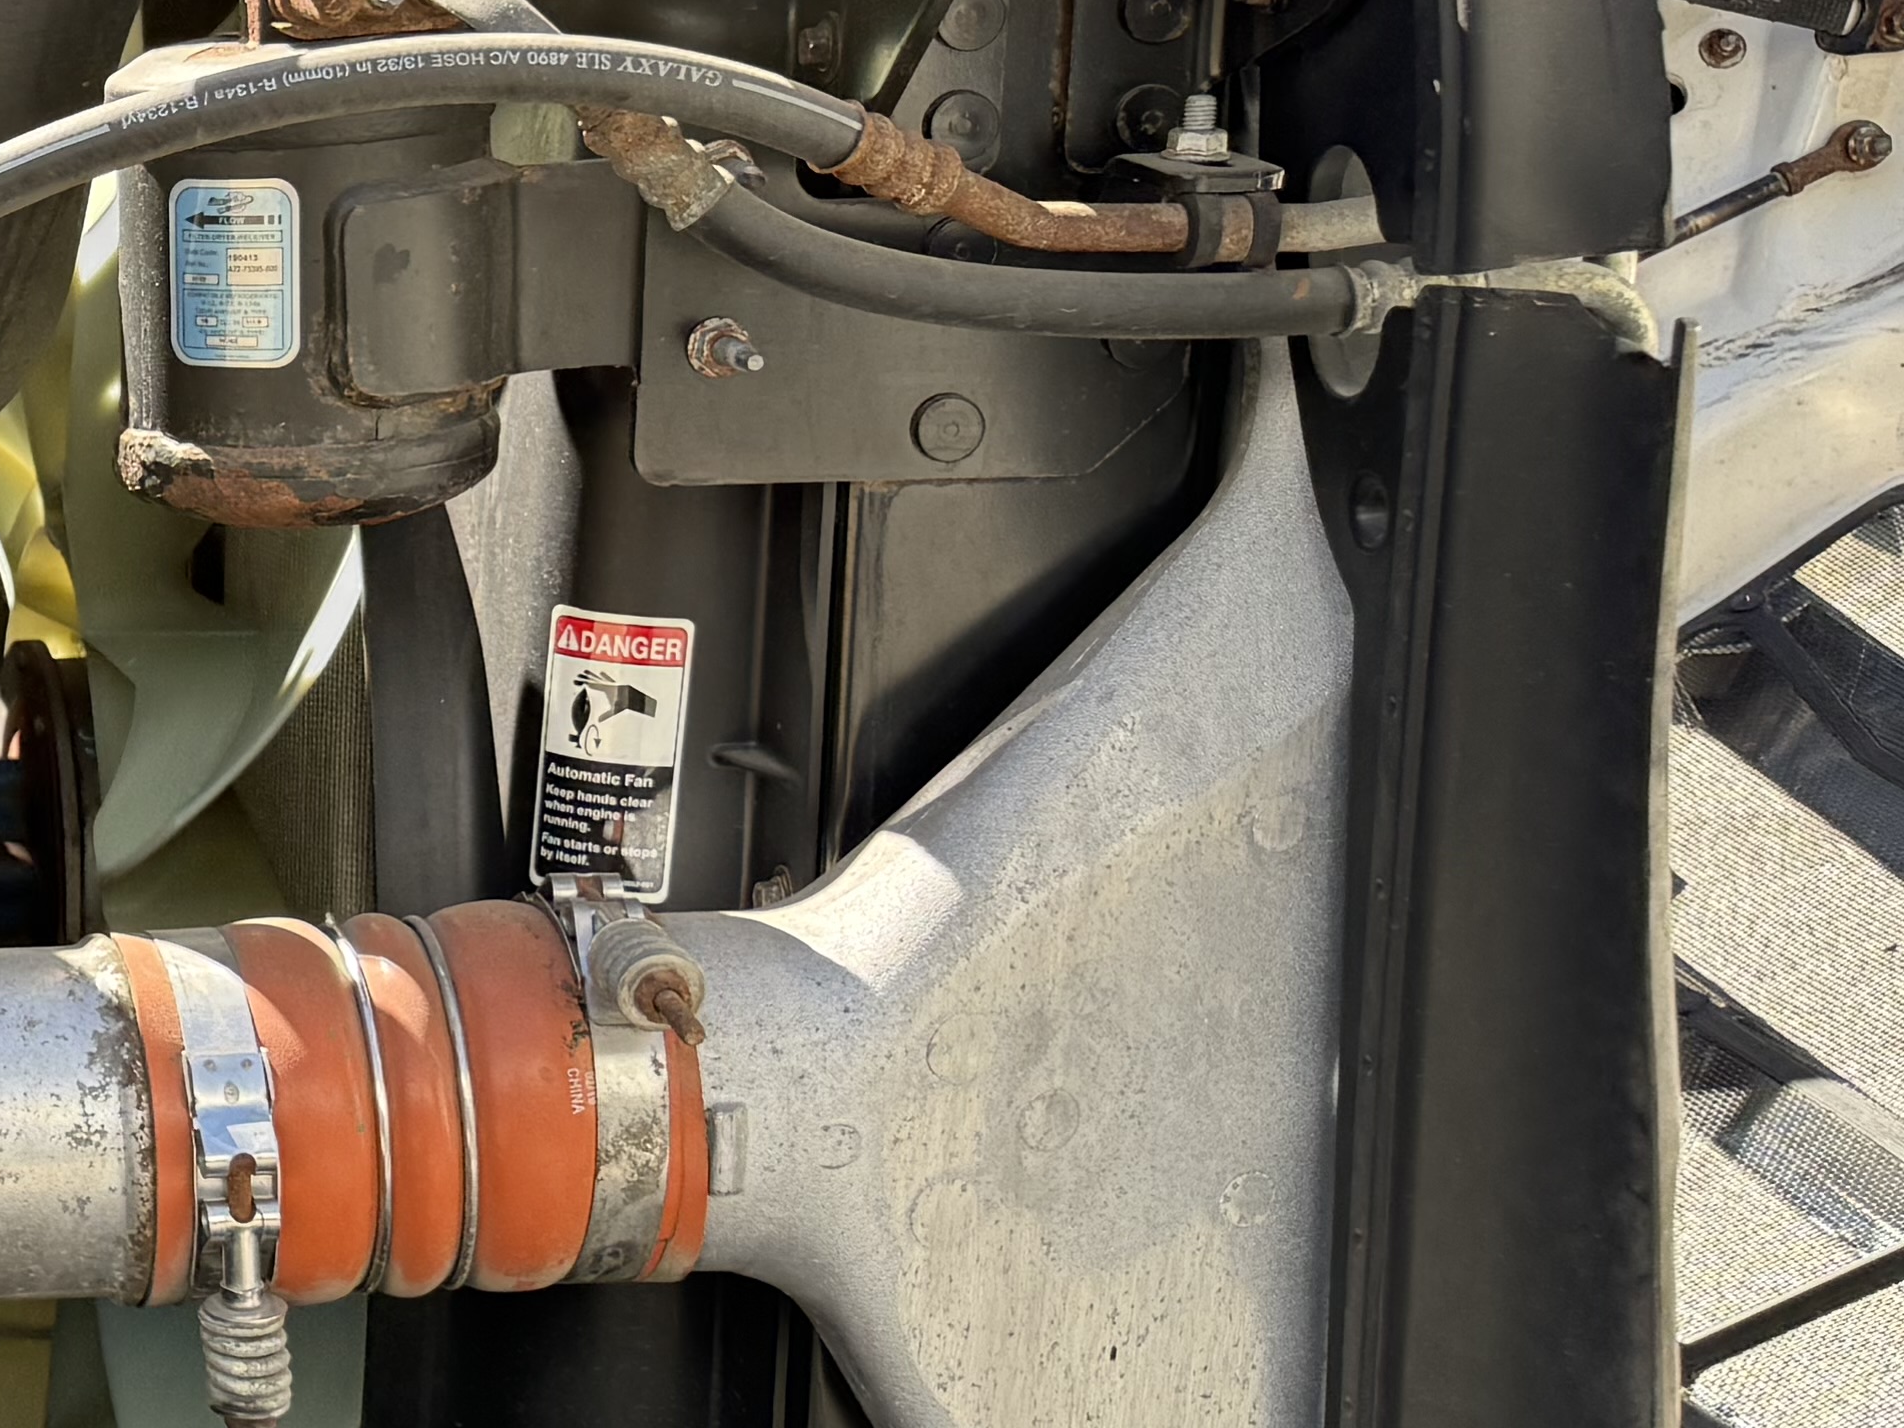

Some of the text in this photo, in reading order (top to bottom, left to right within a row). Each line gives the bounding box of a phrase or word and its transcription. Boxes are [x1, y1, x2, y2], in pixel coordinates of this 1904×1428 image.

[376, 54, 426, 72] 13/32
[431, 52, 485, 69] HOSE
[490, 50, 521, 66] A/C
[527, 50, 569, 66] 4890
[575, 51, 613, 71] SLE
[281, 59, 351, 89] (10mm)
[617, 55, 723, 87] GALAXY
[214, 76, 278, 100] R-134a
[580, 630, 684, 662] DANGER
[547, 762, 654, 788] Automatic Fan
[545, 783, 654, 808] Keep hands clear
[544, 799, 636, 822] when engine is
[543, 813, 591, 834] running.
[540, 846, 590, 866] by itself.
[541, 831, 659, 860] Fan starts or stops
[567, 1067, 585, 1115] CHINA
